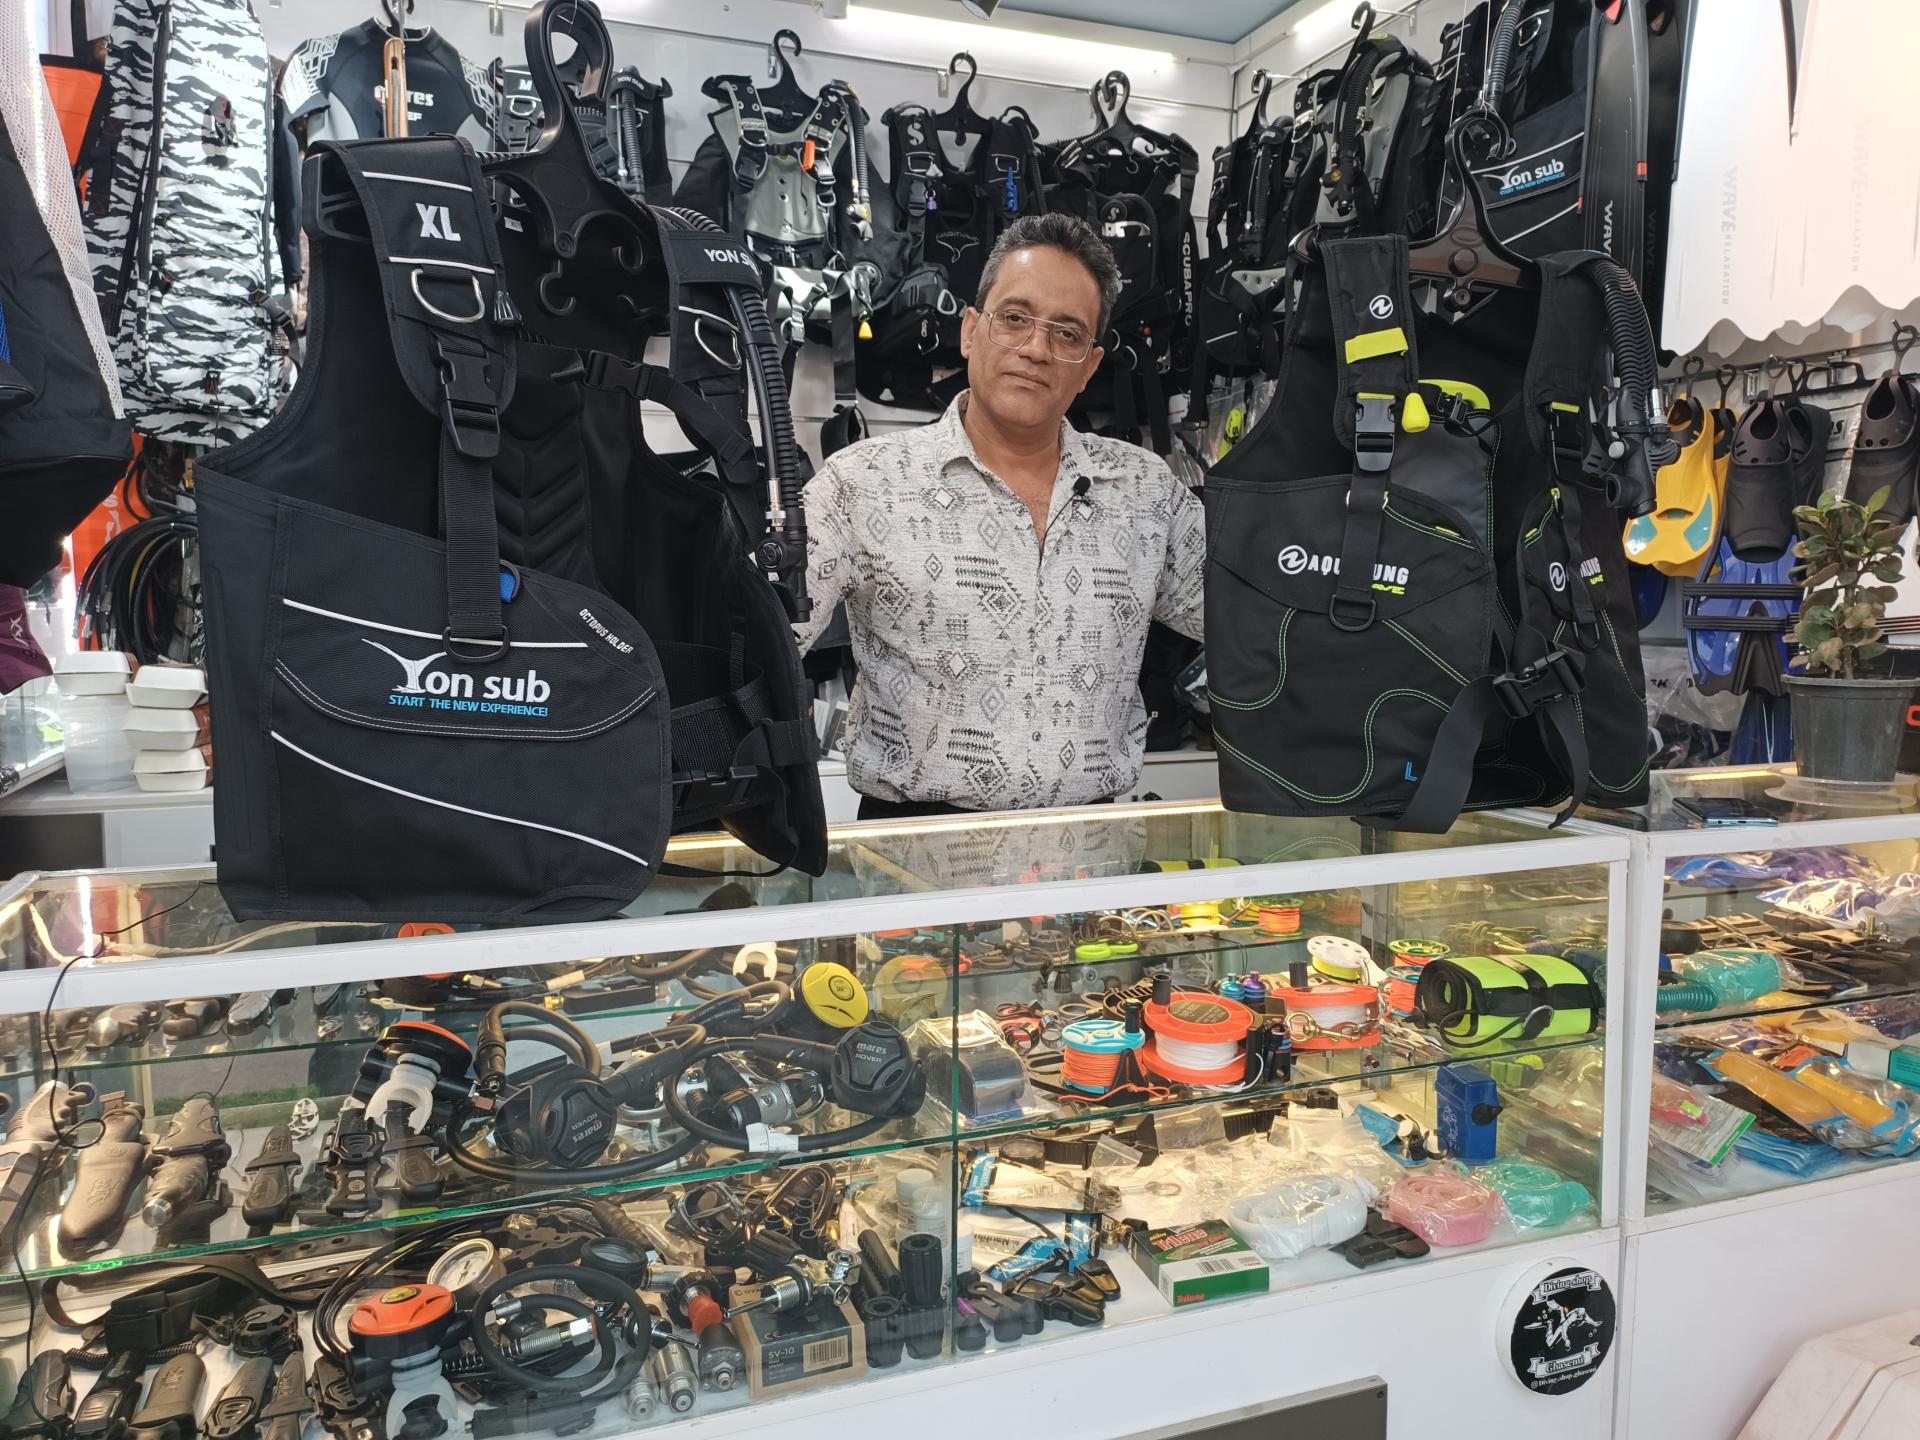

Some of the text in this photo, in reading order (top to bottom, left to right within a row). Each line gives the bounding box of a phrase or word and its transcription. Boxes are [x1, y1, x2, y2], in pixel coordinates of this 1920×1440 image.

[1534, 158, 1564, 179] sub
[1720, 164, 1739, 233] WAVE
[415, 202, 461, 242] XL
[1603, 200, 1614, 254] WAV
[703, 248, 740, 264] YON
[1182, 231, 1194, 327] SCUBAPRO
[579, 608, 634, 654] OCTOPUS HOLDER
[361, 638, 551, 703] Yon sub
[388, 694, 549, 718] START THE NEW EXPERIENCE!
[1404, 761, 1418, 782] L
[855, 1053, 882, 1063] ROVER
[856, 1042, 888, 1055] mares
[571, 1120, 603, 1143] mares
[1543, 1274, 1592, 1293] Diving shop
[768, 1346, 795, 1359] SV-10
[1545, 1354, 1585, 1373] Ghasemi
